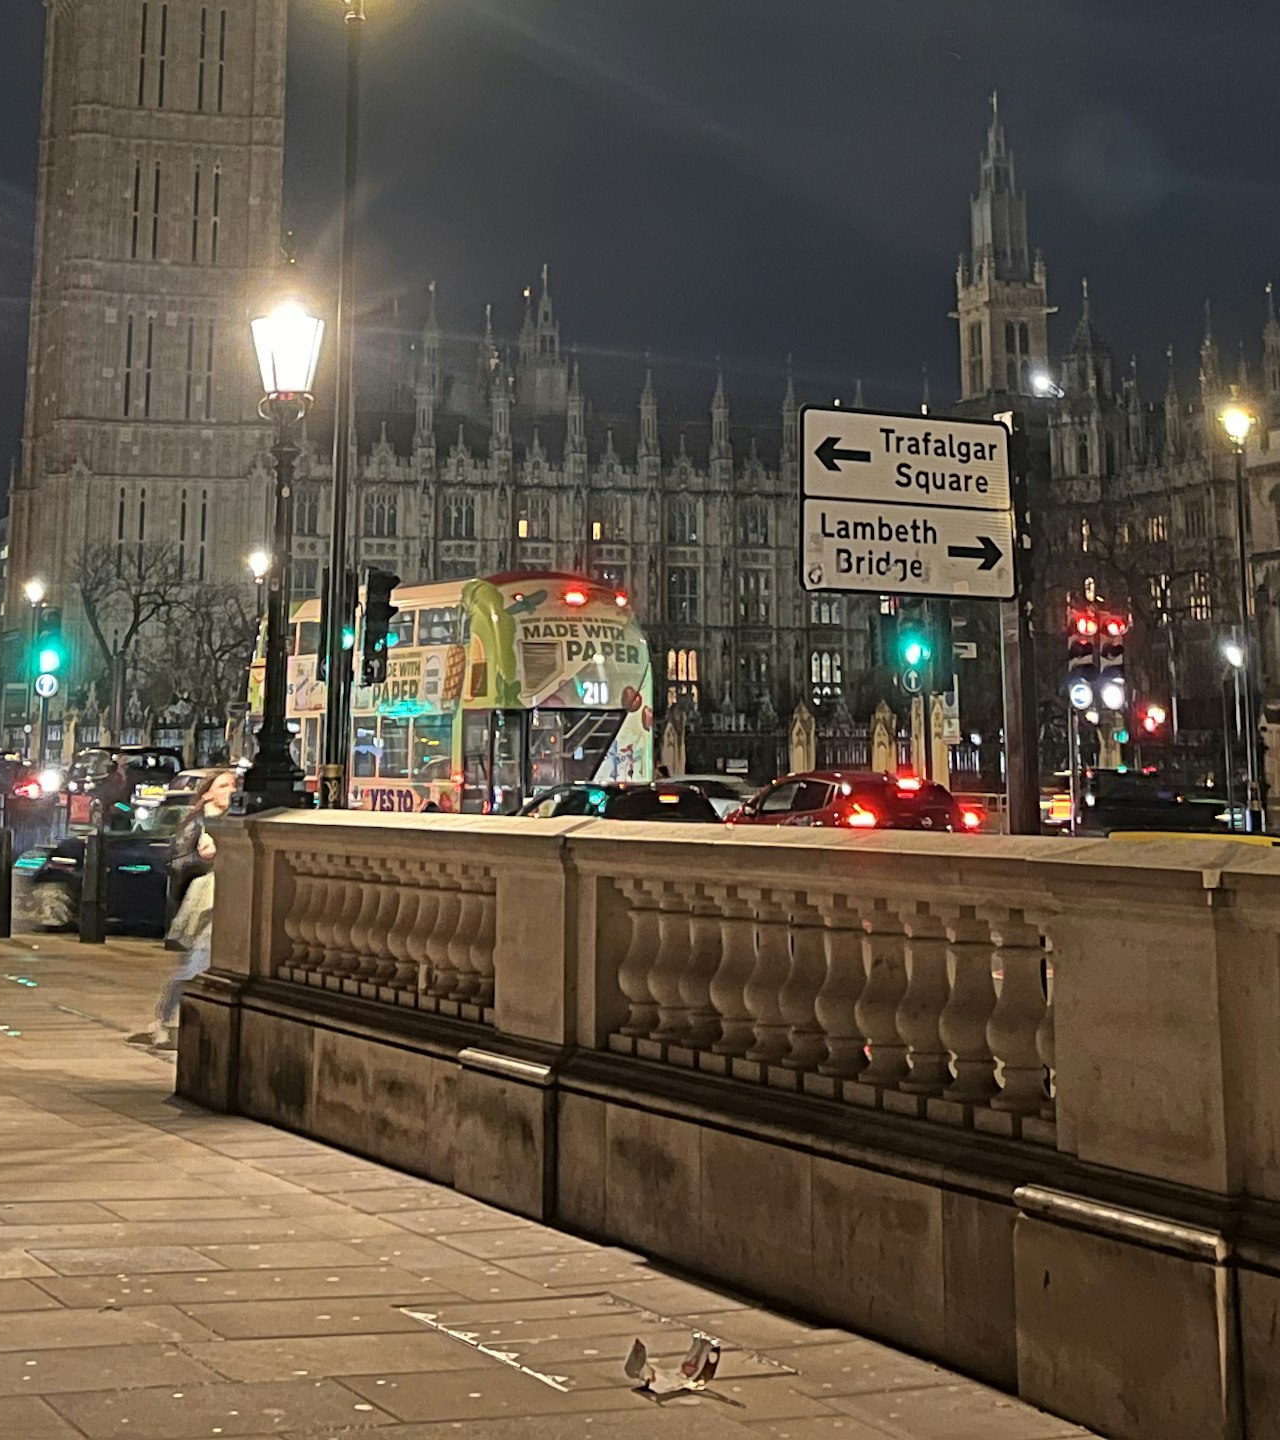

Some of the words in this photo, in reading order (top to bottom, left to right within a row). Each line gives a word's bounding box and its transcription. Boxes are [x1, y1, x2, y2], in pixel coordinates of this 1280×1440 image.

[879, 427, 998, 464] Trafalgar
[894, 462, 989, 495] Square
[820, 512, 938, 545] Lambeth
[836, 548, 923, 583] Bridge
[522, 623, 580, 640] MADE
[582, 623, 626, 642] WITH
[566, 640, 640, 664] PAPER
[370, 788, 395, 812] YES
[397, 789, 414, 812] TO
